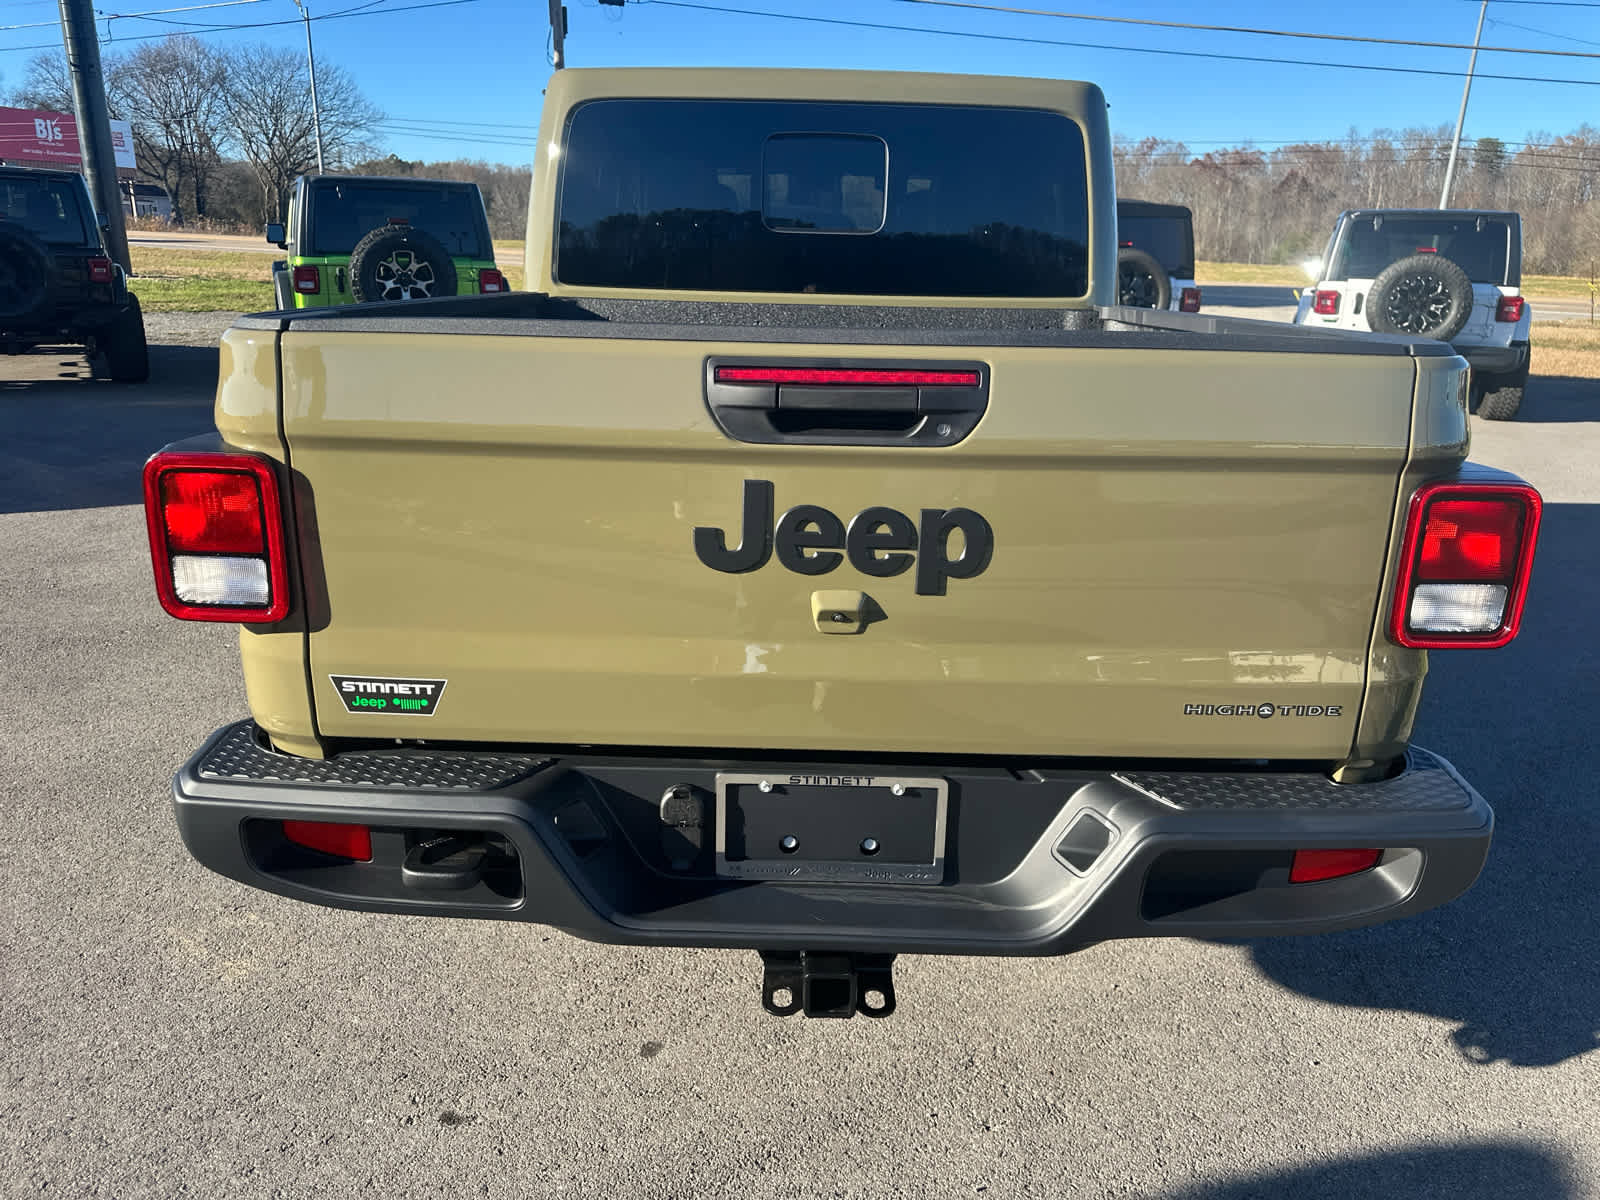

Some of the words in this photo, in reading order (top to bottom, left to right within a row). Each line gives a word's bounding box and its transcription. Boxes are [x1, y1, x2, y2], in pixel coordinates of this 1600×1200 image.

[34, 117, 63, 142] BJ's
[693, 479, 994, 596] Jeep
[342, 681, 435, 695] STINNETT
[352, 696, 387, 710] Jeep
[1183, 703, 1256, 716] HIGH
[1277, 705, 1343, 717] TIDE
[789, 775, 876, 787] STINNETT
